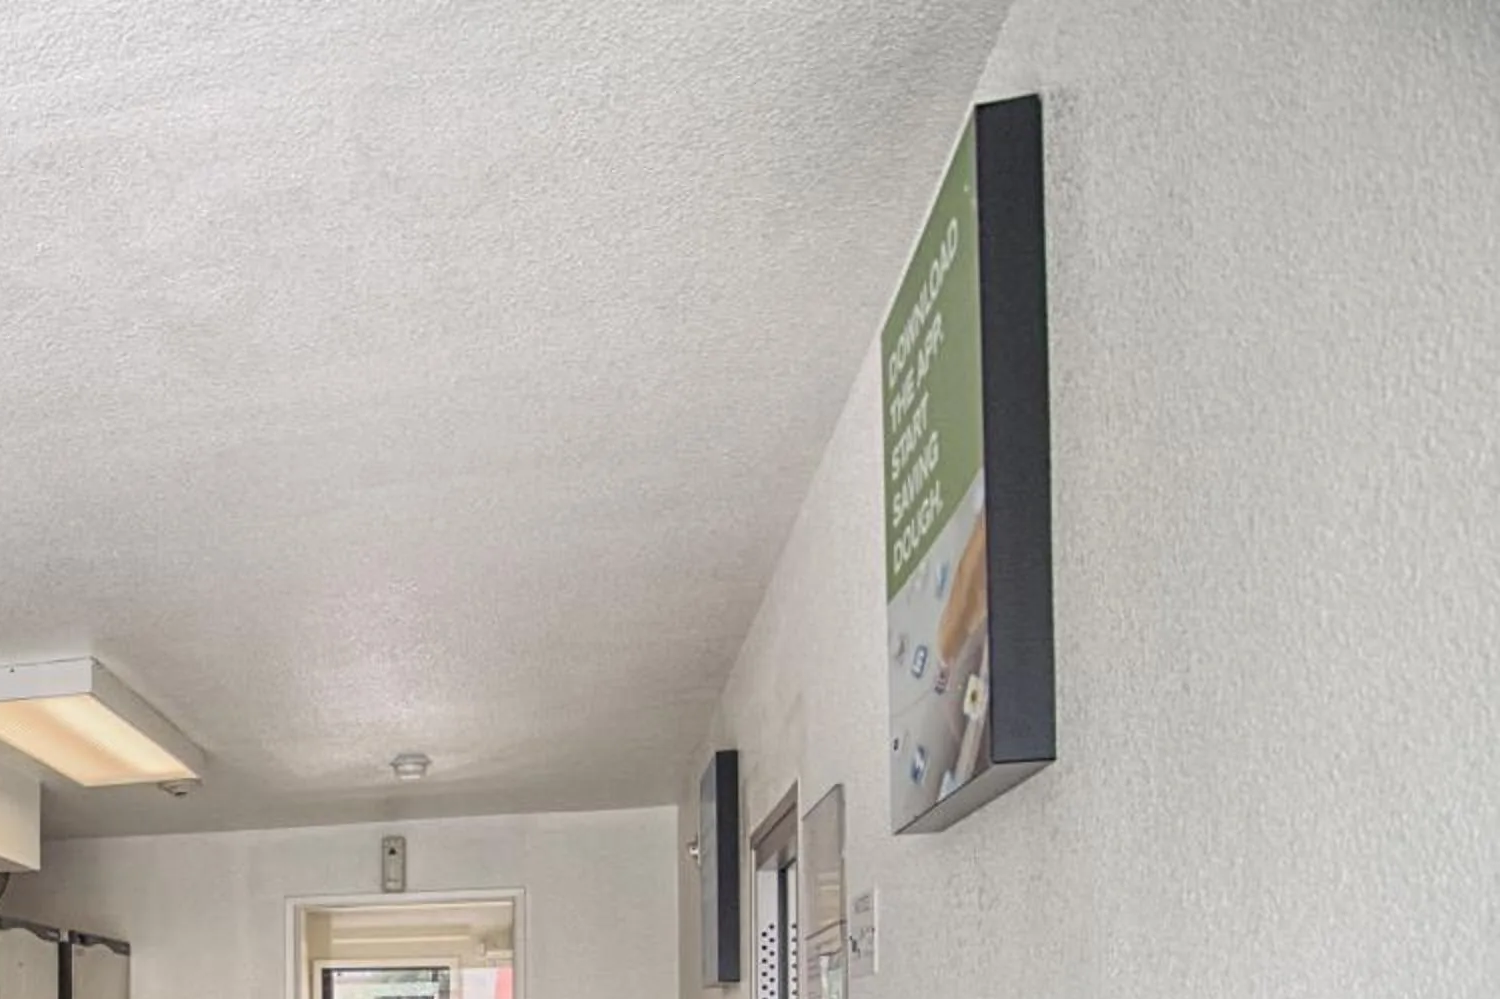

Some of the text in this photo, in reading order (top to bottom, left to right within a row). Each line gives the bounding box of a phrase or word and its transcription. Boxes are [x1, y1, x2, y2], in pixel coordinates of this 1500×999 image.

[888, 216, 959, 389] DOWNLOAD
[890, 367, 915, 434] THE
[891, 391, 930, 482] START
[893, 430, 940, 529] SAVING
